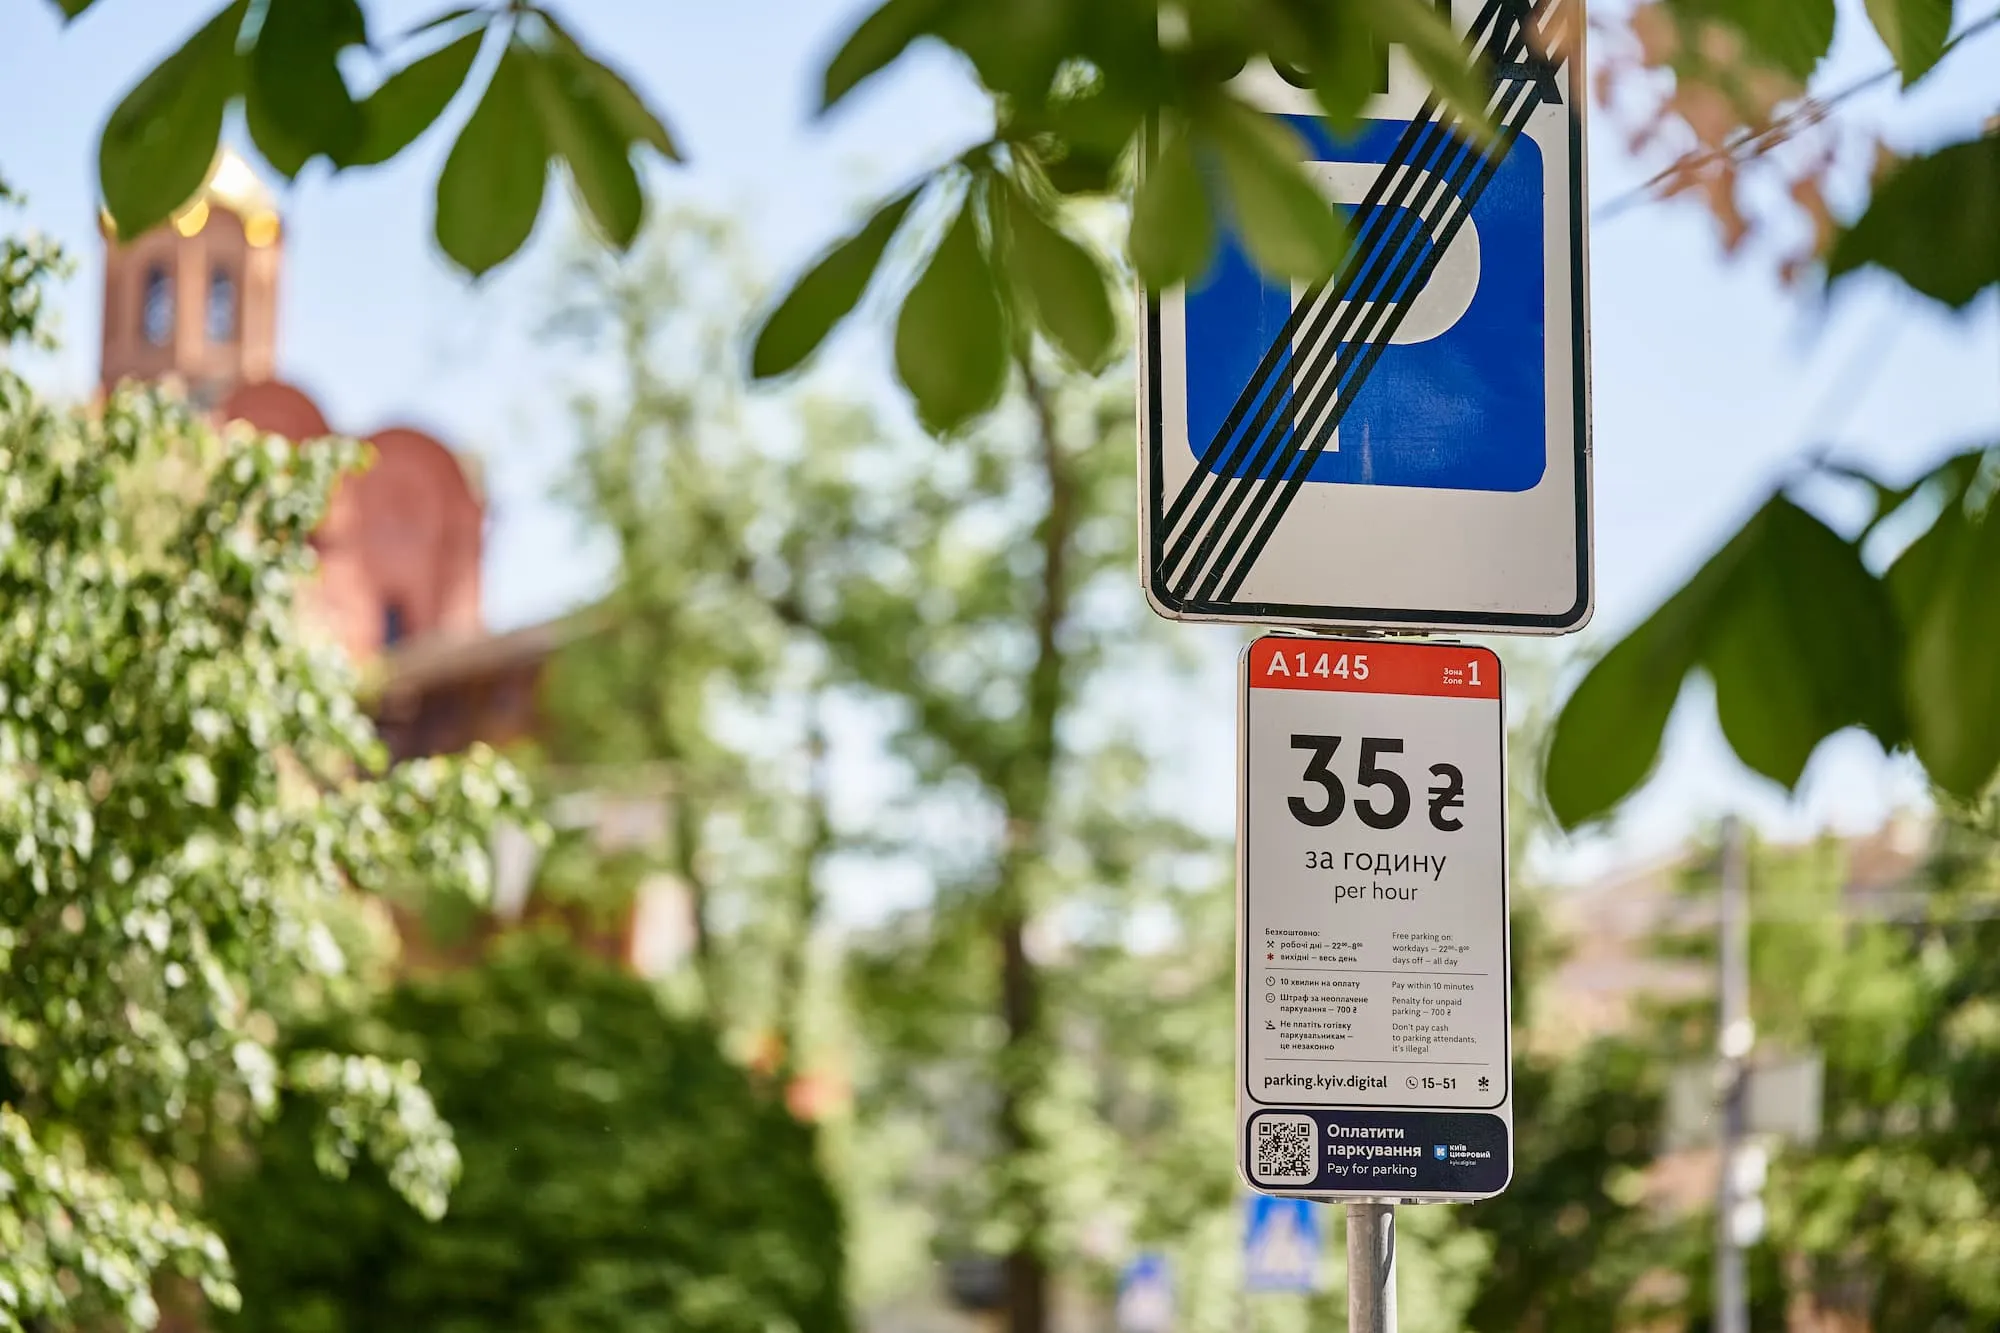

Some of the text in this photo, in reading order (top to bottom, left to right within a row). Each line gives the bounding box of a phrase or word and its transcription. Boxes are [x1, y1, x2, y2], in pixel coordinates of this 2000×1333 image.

[1267, 651, 1369, 680] A1445
[1444, 668, 1462, 676] Зона
[1468, 661, 1481, 685] 1
[1288, 734, 1411, 829] 35
[1305, 851, 1446, 881] за годину
[1335, 882, 1418, 903] per hour
[1266, 928, 1320, 936] Безкоштовно:
[1412, 933, 1439, 942] parking
[1392, 957, 1409, 965] days
[1444, 958, 1458, 966] day
[1392, 981, 1405, 990] Pay
[1281, 994, 1308, 1003] Штраф
[1392, 997, 1420, 1006] Penalty
[1436, 998, 1462, 1006] unpaid
[1392, 1008, 1421, 1017] parking
[1324, 1022, 1351, 1030] готівку
[1403, 1035, 1431, 1044] parking
[1406, 1045, 1428, 1054] illegal
[1264, 1073, 1387, 1090] parking.kyiv.digital
[1327, 1124, 1404, 1138] Оплатити
[1328, 1145, 1421, 1159] паркування
[1328, 1163, 1417, 1177] Pay for parking
